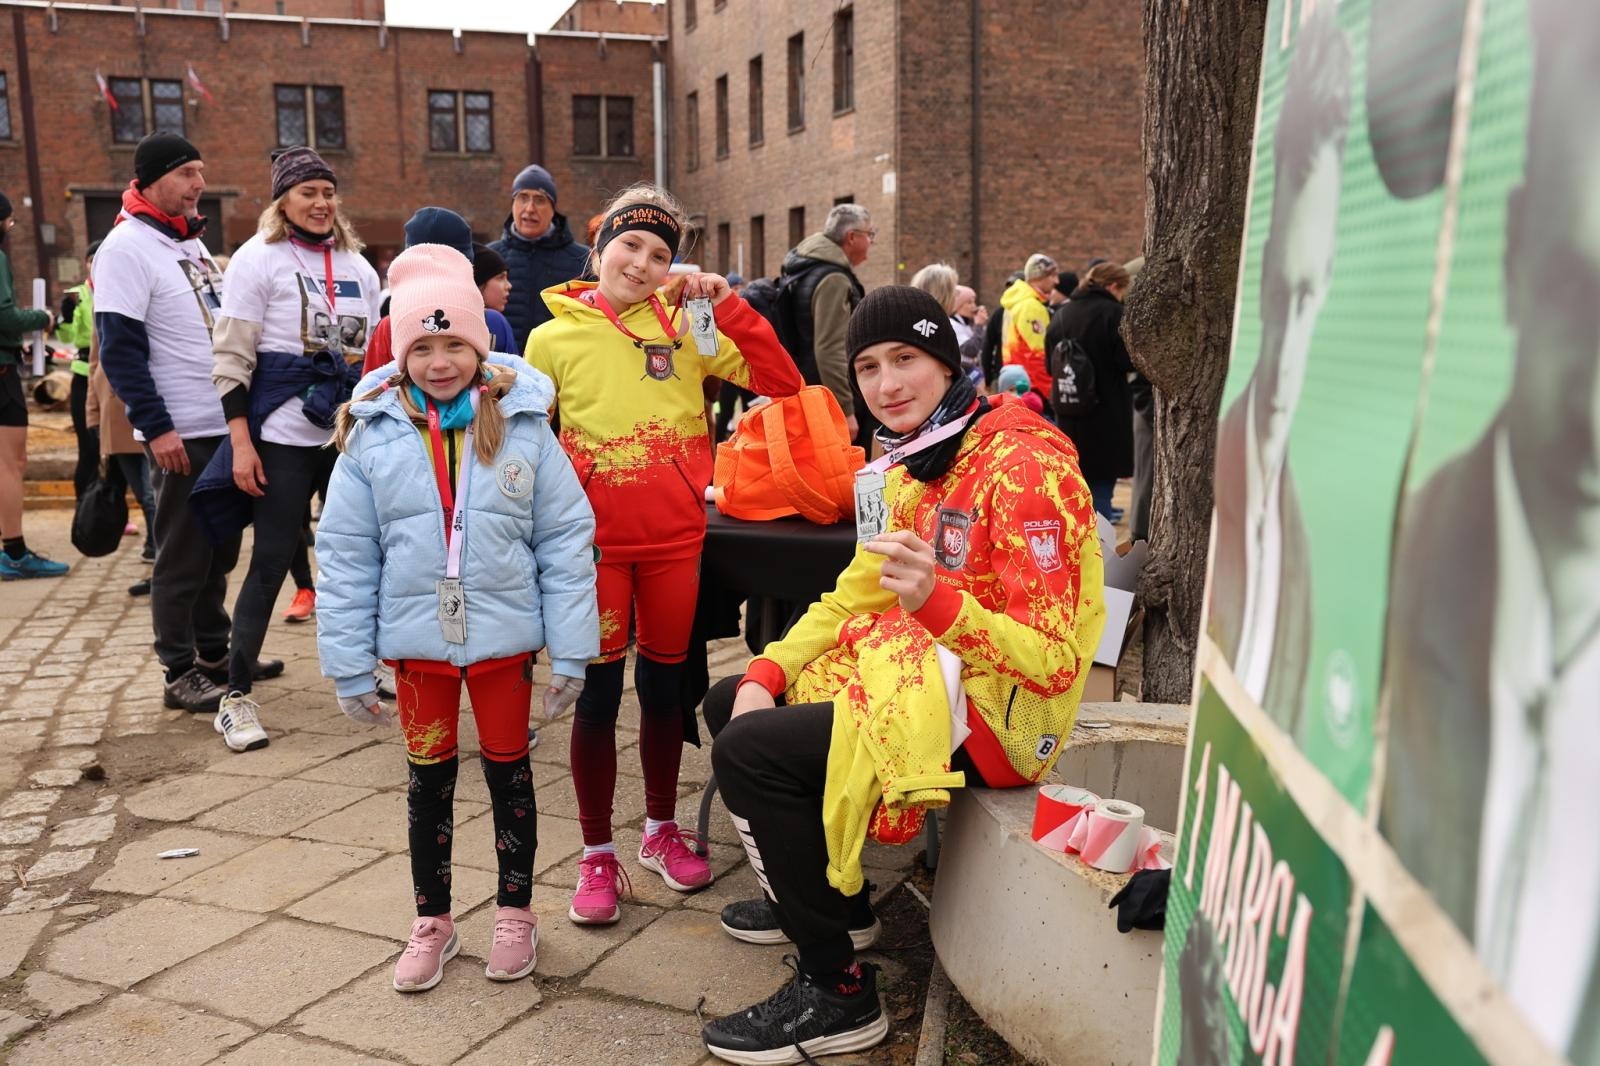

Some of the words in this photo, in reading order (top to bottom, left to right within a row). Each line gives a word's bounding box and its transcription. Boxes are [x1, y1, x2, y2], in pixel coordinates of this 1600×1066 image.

[912, 318, 939, 338] 4F
[1023, 519, 1060, 528] POLSKA
[1038, 741, 1053, 756] B
[1200, 763, 1313, 1066] MARCA
